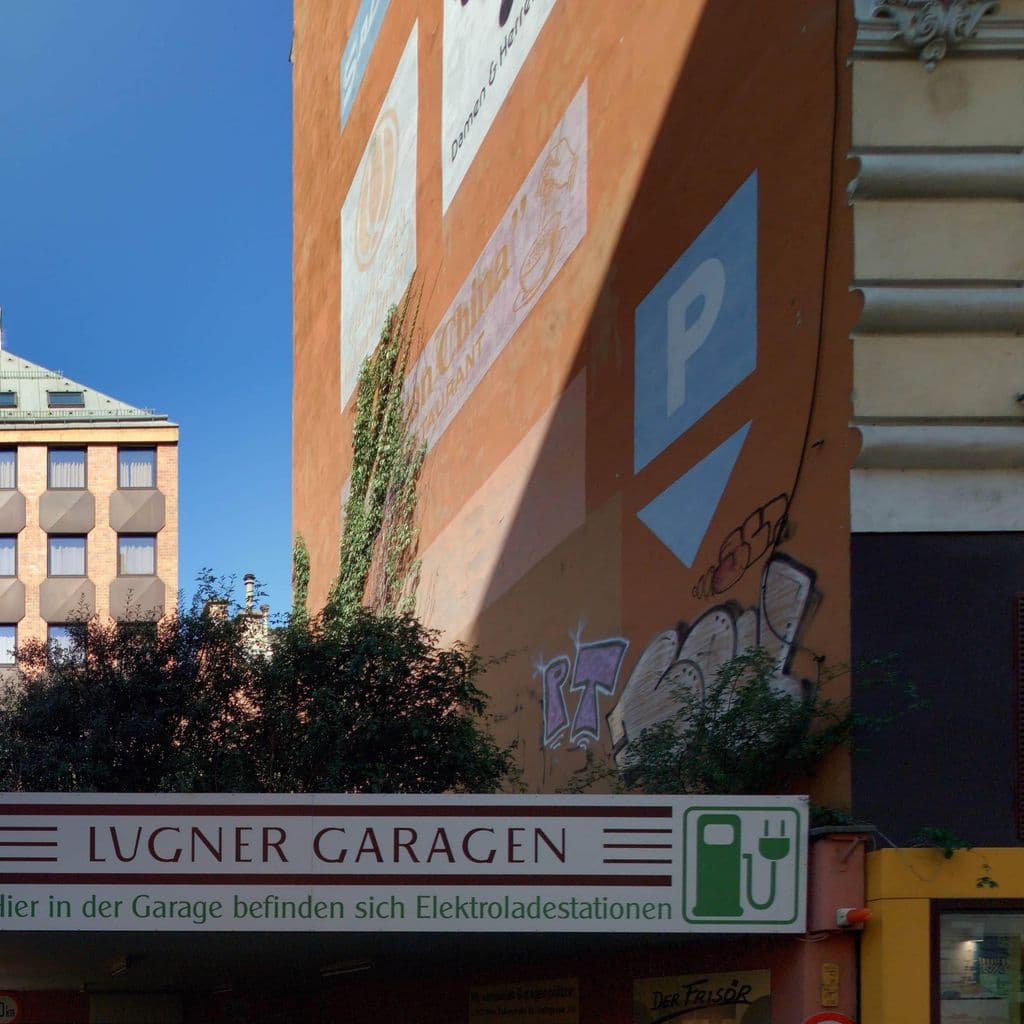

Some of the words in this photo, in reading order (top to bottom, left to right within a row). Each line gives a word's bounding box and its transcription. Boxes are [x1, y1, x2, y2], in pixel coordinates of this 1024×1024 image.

[451, 87, 486, 162] Damen
[667, 257, 726, 418] P
[89, 826, 289, 863] LUGNER
[312, 826, 566, 864] GARAGEN
[48, 894, 72, 918] in
[82, 894, 123, 918] der
[132, 895, 222, 924] Garage
[233, 894, 345, 919] befinden
[355, 895, 405, 919] sich
[416, 895, 673, 920] Elektroladestationen
[651, 991, 680, 1010] DER
